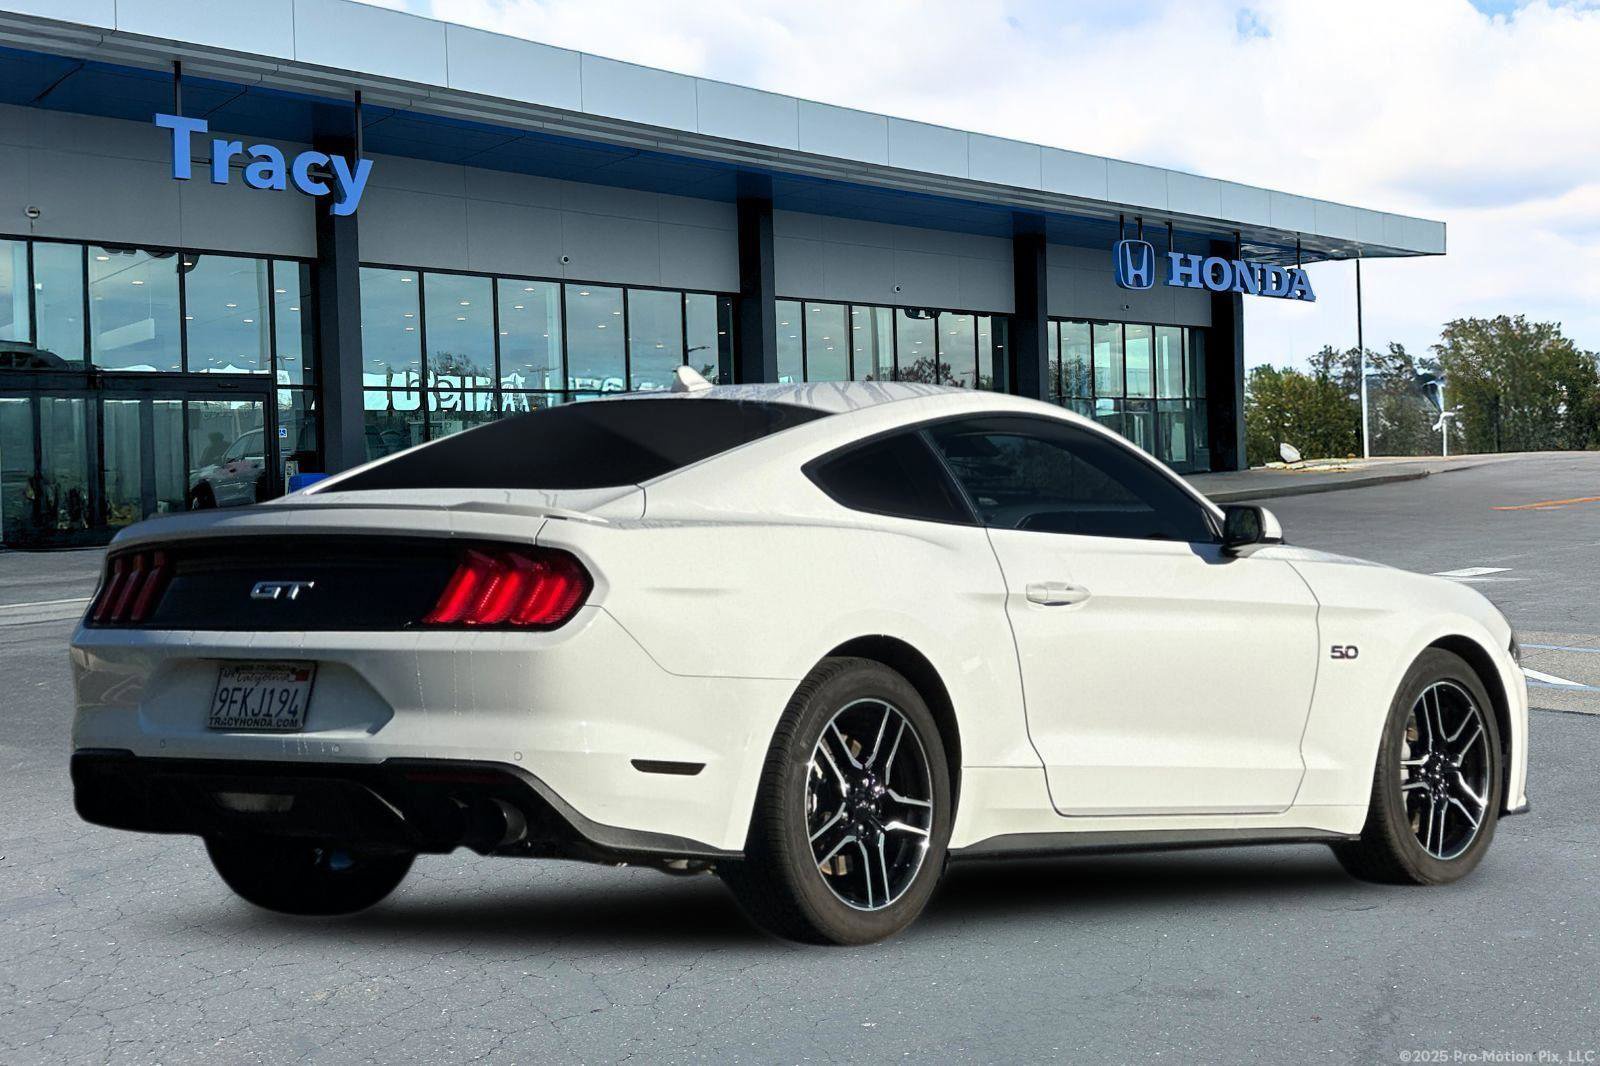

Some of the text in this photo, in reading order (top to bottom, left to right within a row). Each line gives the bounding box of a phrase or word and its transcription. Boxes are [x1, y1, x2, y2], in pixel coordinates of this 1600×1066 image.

[155, 113, 374, 216] Tracy
[1166, 251, 1317, 301] HONDA
[250, 580, 315, 600] GT
[214, 687, 299, 718] 9FKJ194
